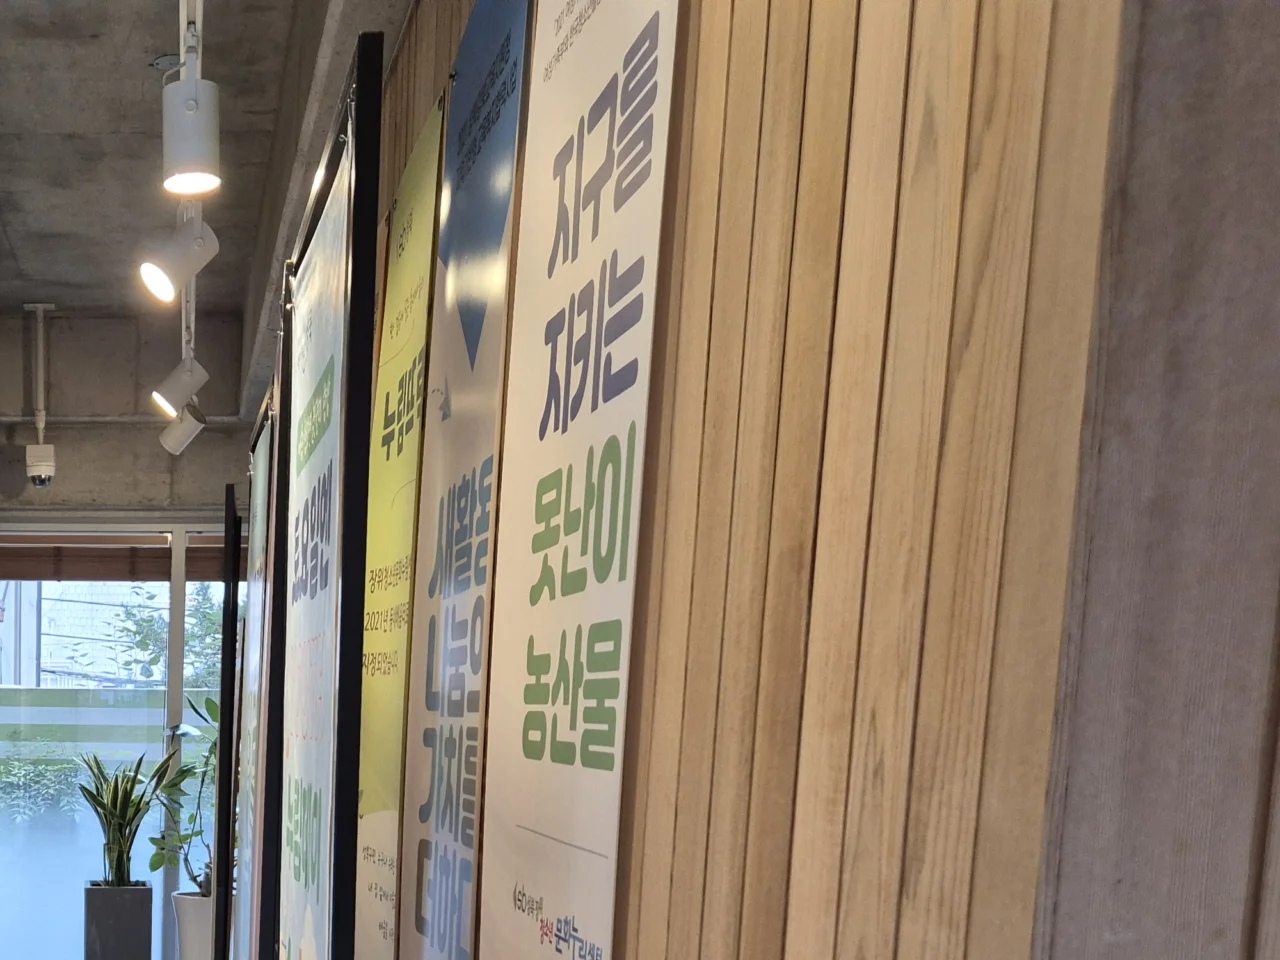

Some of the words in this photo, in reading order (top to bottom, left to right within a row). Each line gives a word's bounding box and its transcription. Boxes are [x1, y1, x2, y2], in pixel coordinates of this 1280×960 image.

[548, 10, 660, 279] 지구를
[538, 249, 645, 442] 지키는
[530, 420, 636, 606] 못난이
[364, 611, 388, 633] 2021년
[522, 620, 623, 772] 농산물
